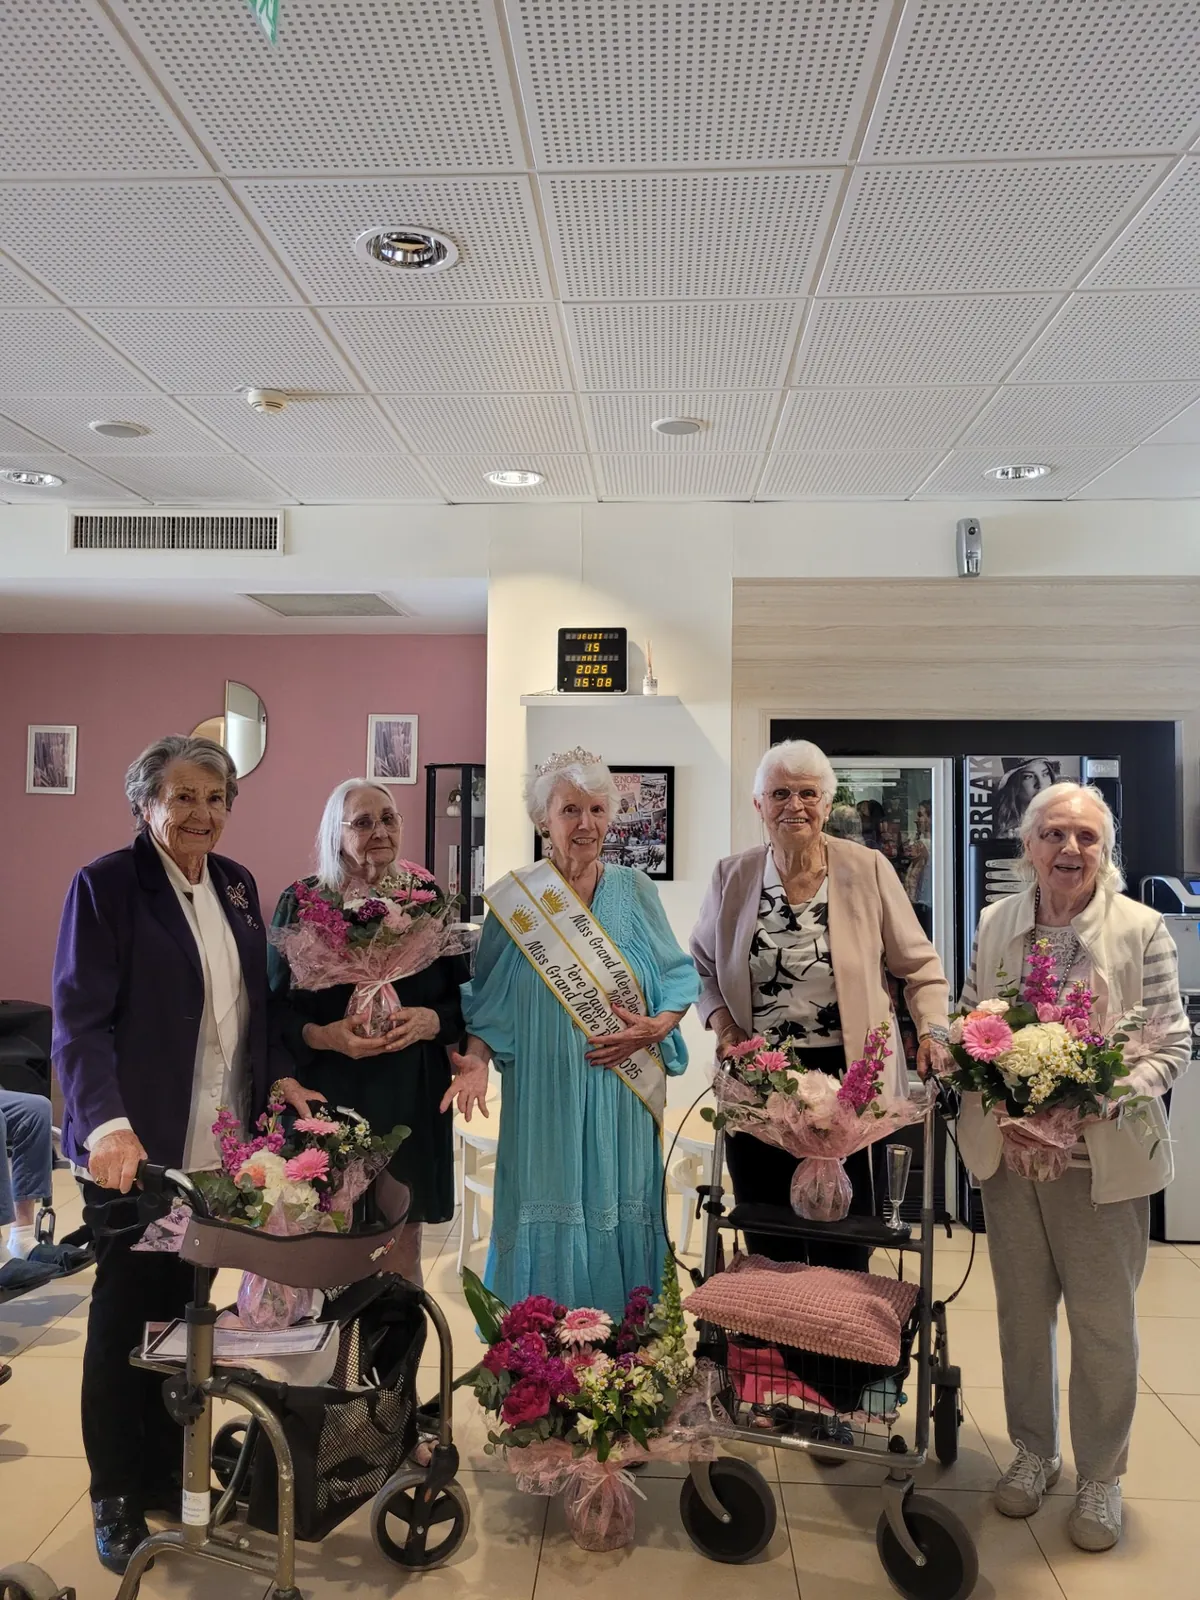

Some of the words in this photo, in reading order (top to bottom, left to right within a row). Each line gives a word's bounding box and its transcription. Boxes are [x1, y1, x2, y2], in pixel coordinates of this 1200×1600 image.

[581, 654, 598, 662] MAI
[587, 642, 600, 652] 15
[575, 677, 613, 687] 15:08
[576, 665, 608, 674] 2025
[969, 756, 993, 841] BREAK
[569, 914, 593, 938] Miss
[589, 937, 621, 970] Grand
[610, 969, 631, 997] Mère
[525, 940, 549, 966] Miss
[545, 965, 582, 1003] Grand
[572, 1001, 600, 1032] Mère
[619, 1057, 643, 1080] 025
[564, 963, 587, 989] 1ère
[583, 986, 621, 1035] Dauphin
